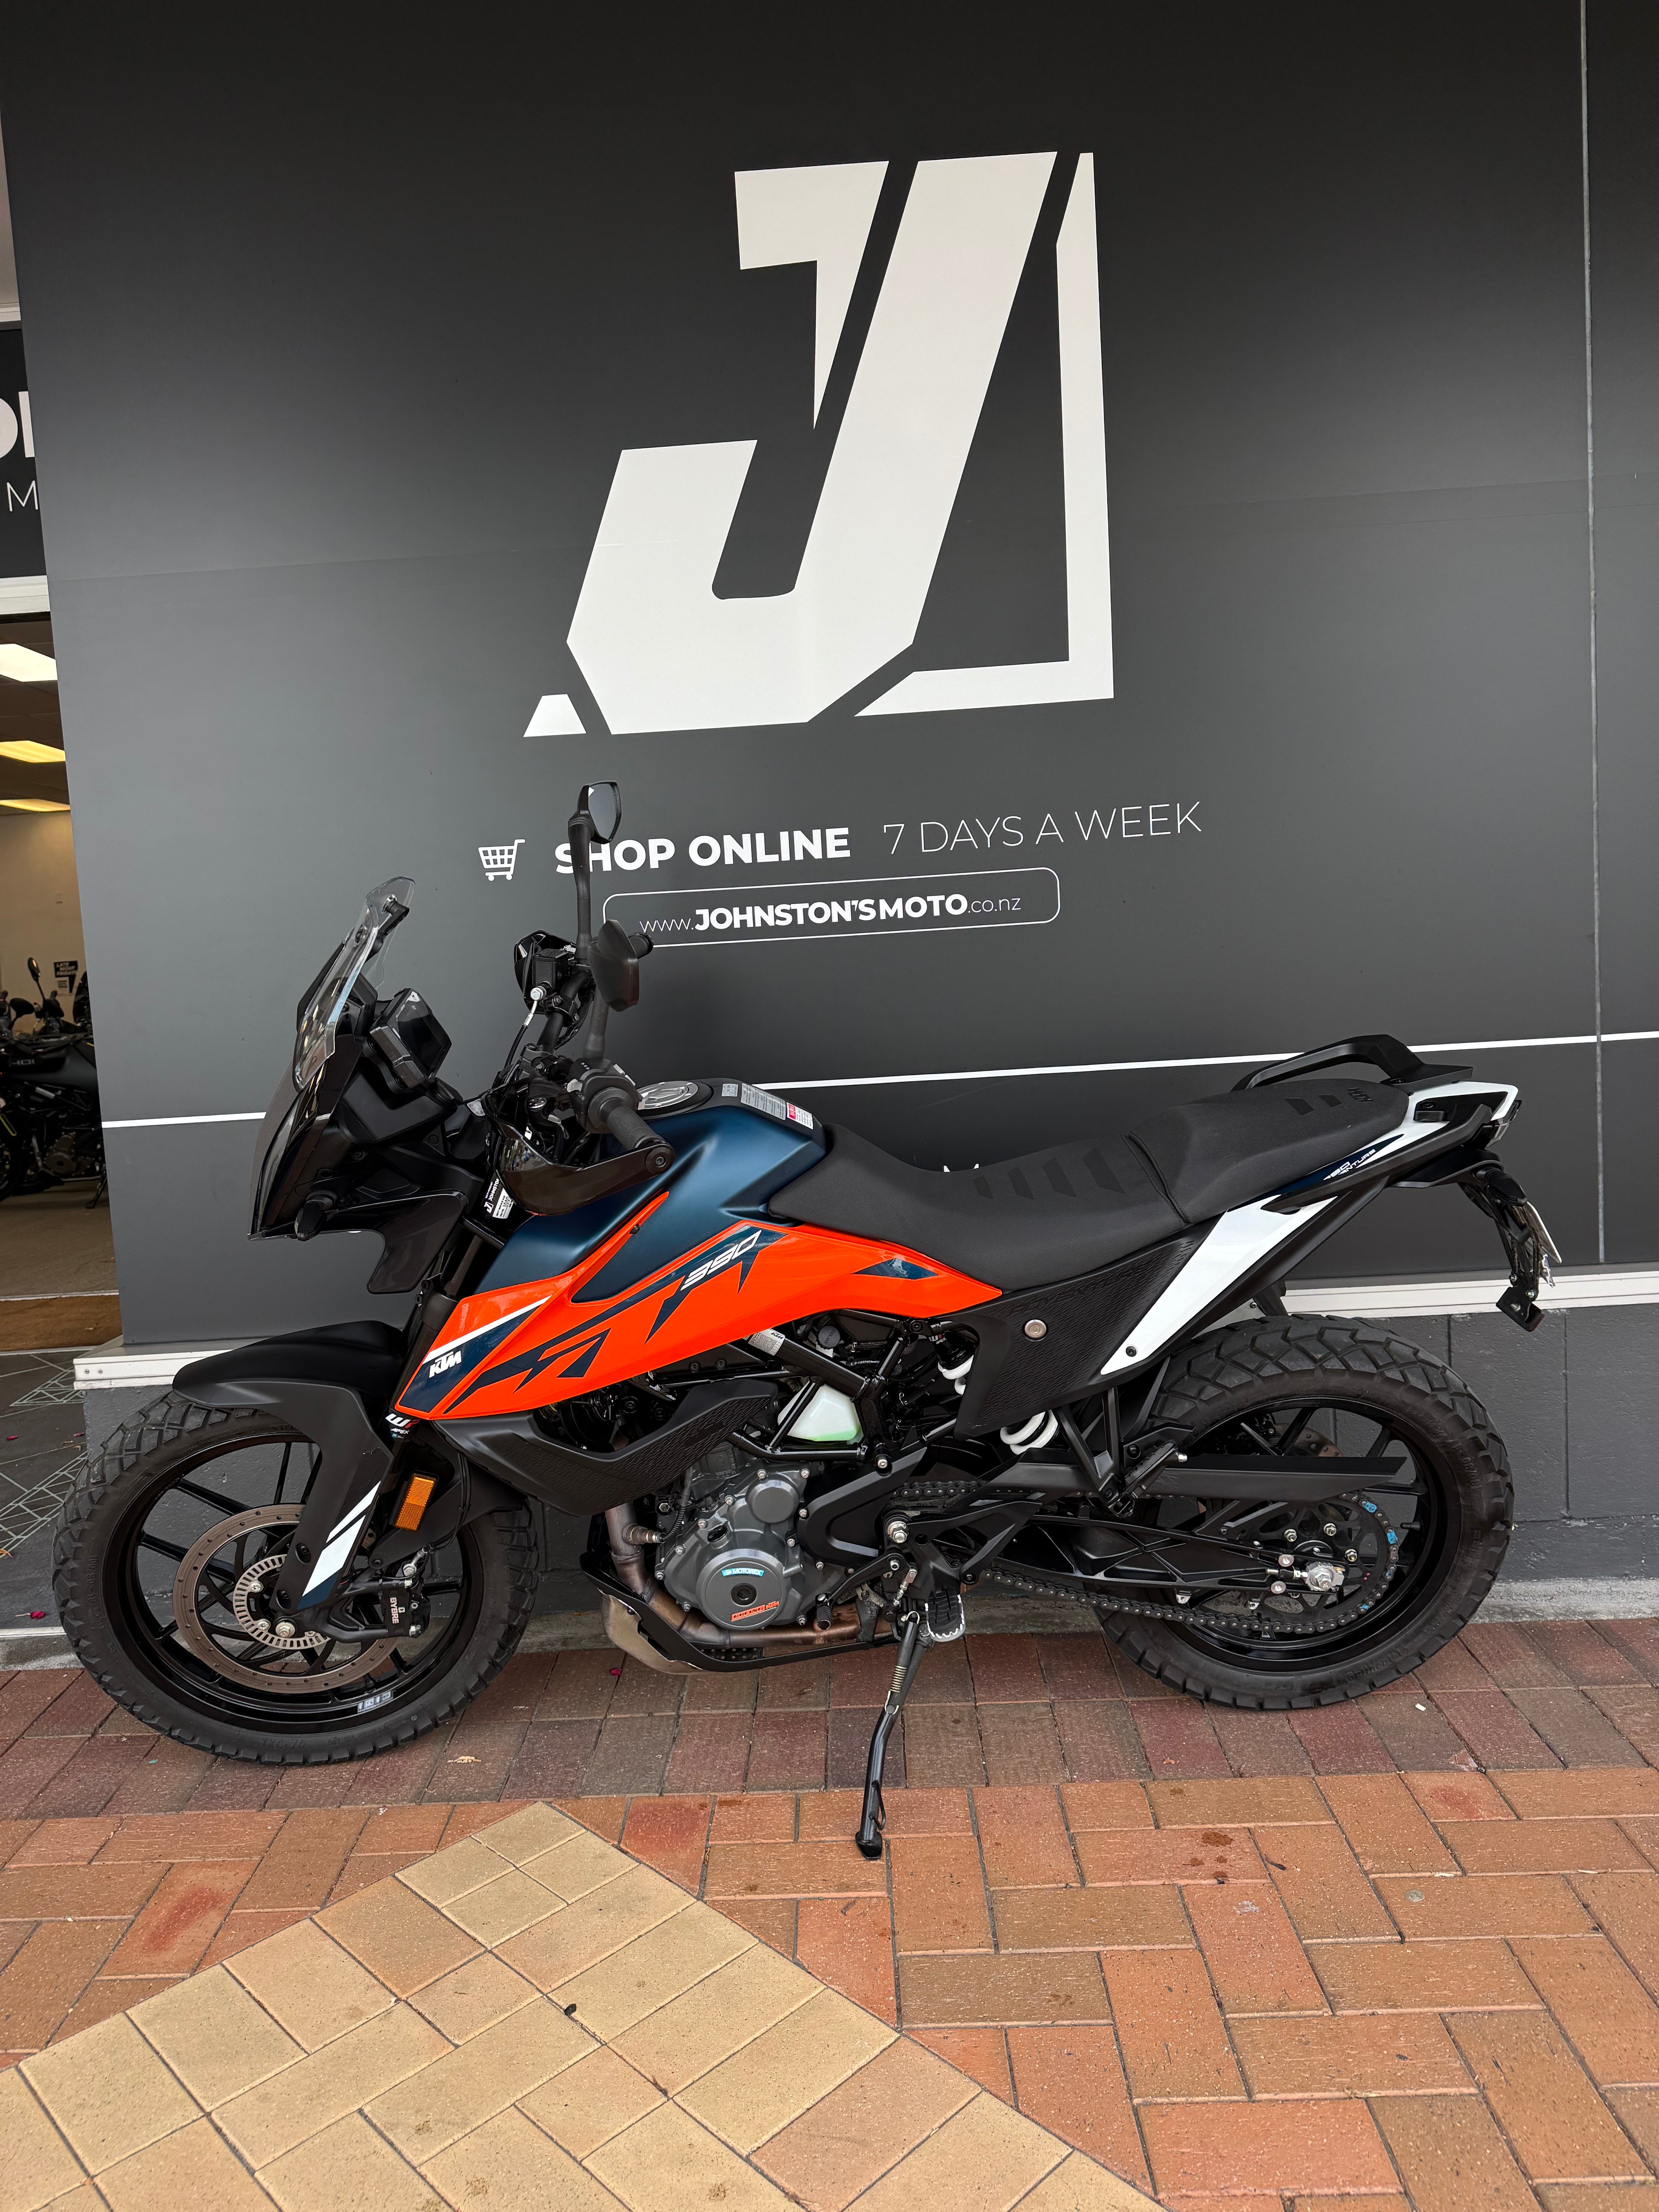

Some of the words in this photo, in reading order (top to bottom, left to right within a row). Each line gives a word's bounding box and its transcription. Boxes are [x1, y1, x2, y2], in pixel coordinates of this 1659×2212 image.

[555, 838, 675, 874] SHOP
[689, 827, 850, 866] ONLINE
[883, 823, 905, 855] 7
[921, 815, 1024, 853] DAYS
[1036, 813, 1063, 844] A
[1075, 801, 1202, 840] WEEK
[1338, 1149, 1376, 1175] ENTURE
[680, 1230, 762, 1291] 390
[429, 1350, 462, 1378] KTM
[732, 1568, 764, 1576] MOTOREX
[390, 1597, 399, 1624] BYBRE
